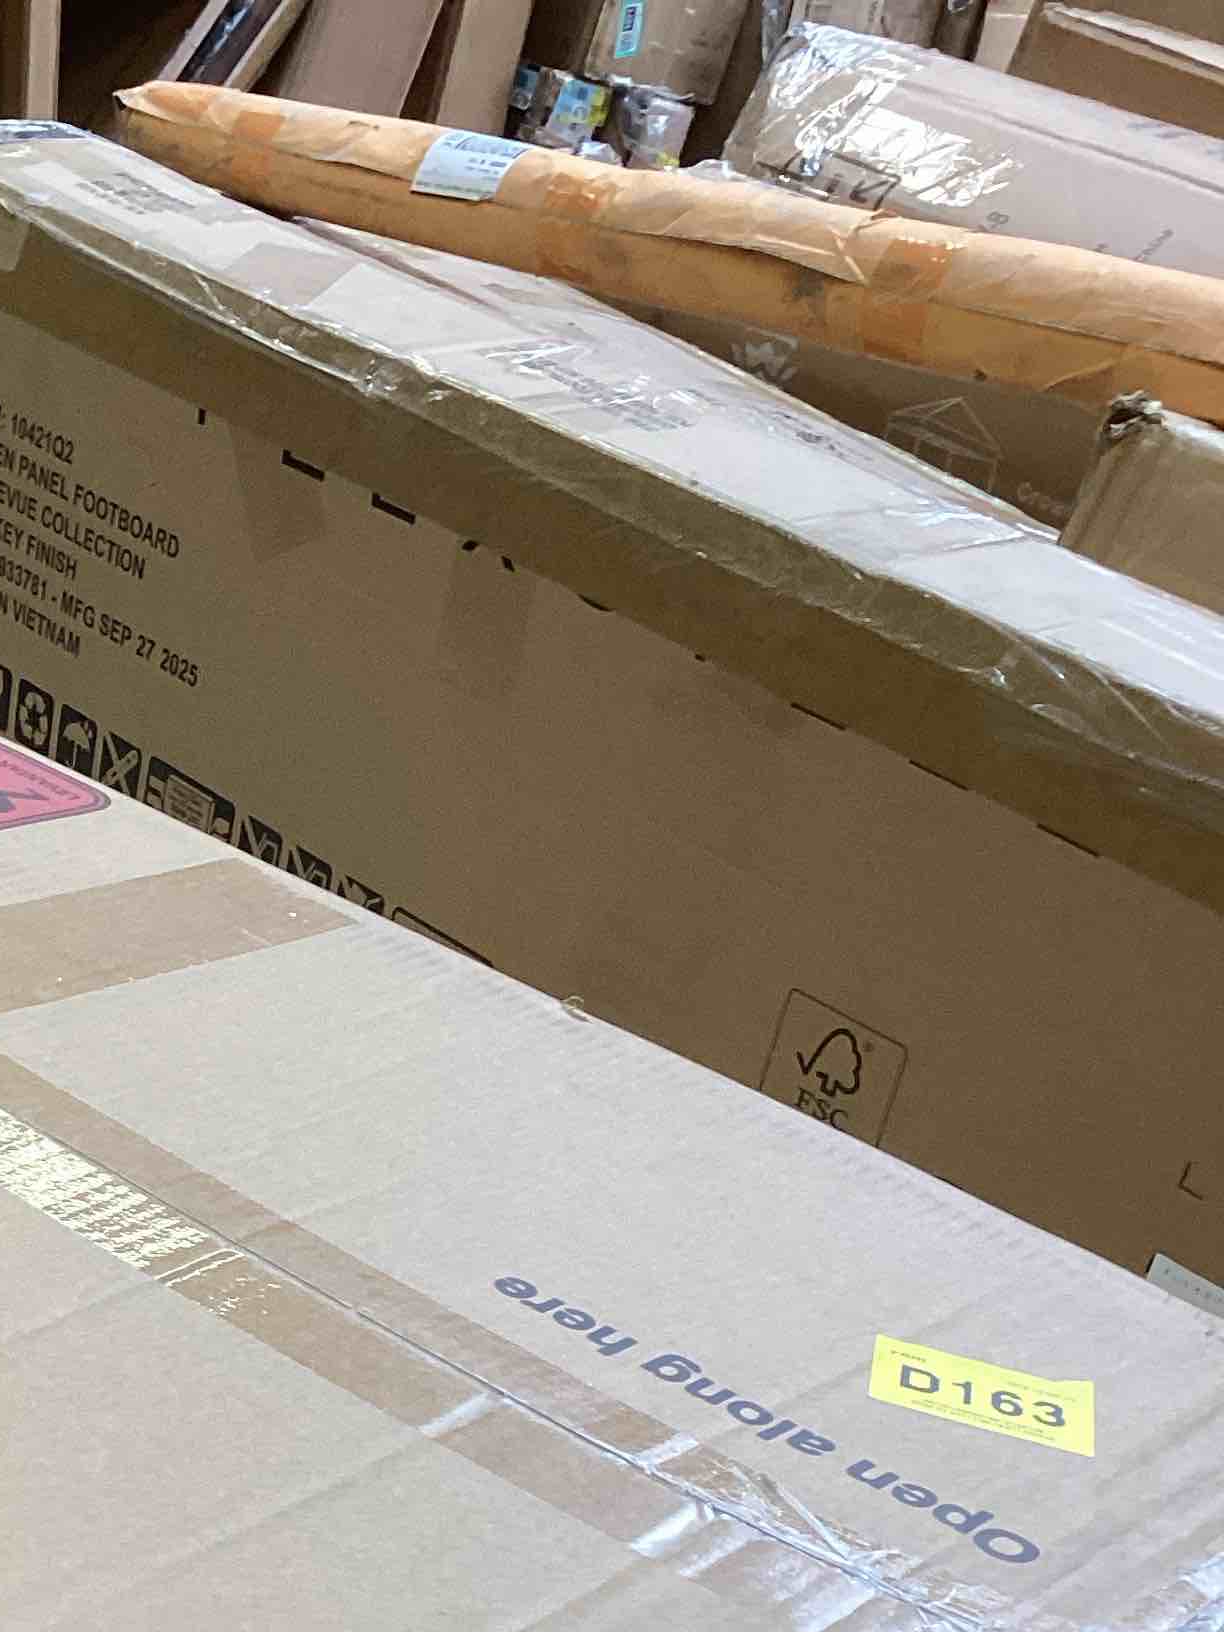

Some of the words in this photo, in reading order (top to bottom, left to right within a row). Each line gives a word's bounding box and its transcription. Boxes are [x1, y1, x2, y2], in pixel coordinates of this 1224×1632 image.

[11, 413, 74, 465] 10421Q2
[18, 455, 69, 501] PANEL
[73, 484, 180, 558] FOOTBOARD
[40, 505, 146, 580] COLLECTION
[26, 535, 77, 581] FINISH
[12, 601, 81, 659] VIETNAM
[60, 591, 96, 629] MFG
[98, 614, 132, 648] SEP
[136, 635, 156, 661] 27
[160, 649, 199, 688] 2025
[493, 1274, 638, 1356] here
[640, 1352, 836, 1457] along
[900, 1364, 1066, 1428] D163
[845, 1457, 1042, 1565] Open
